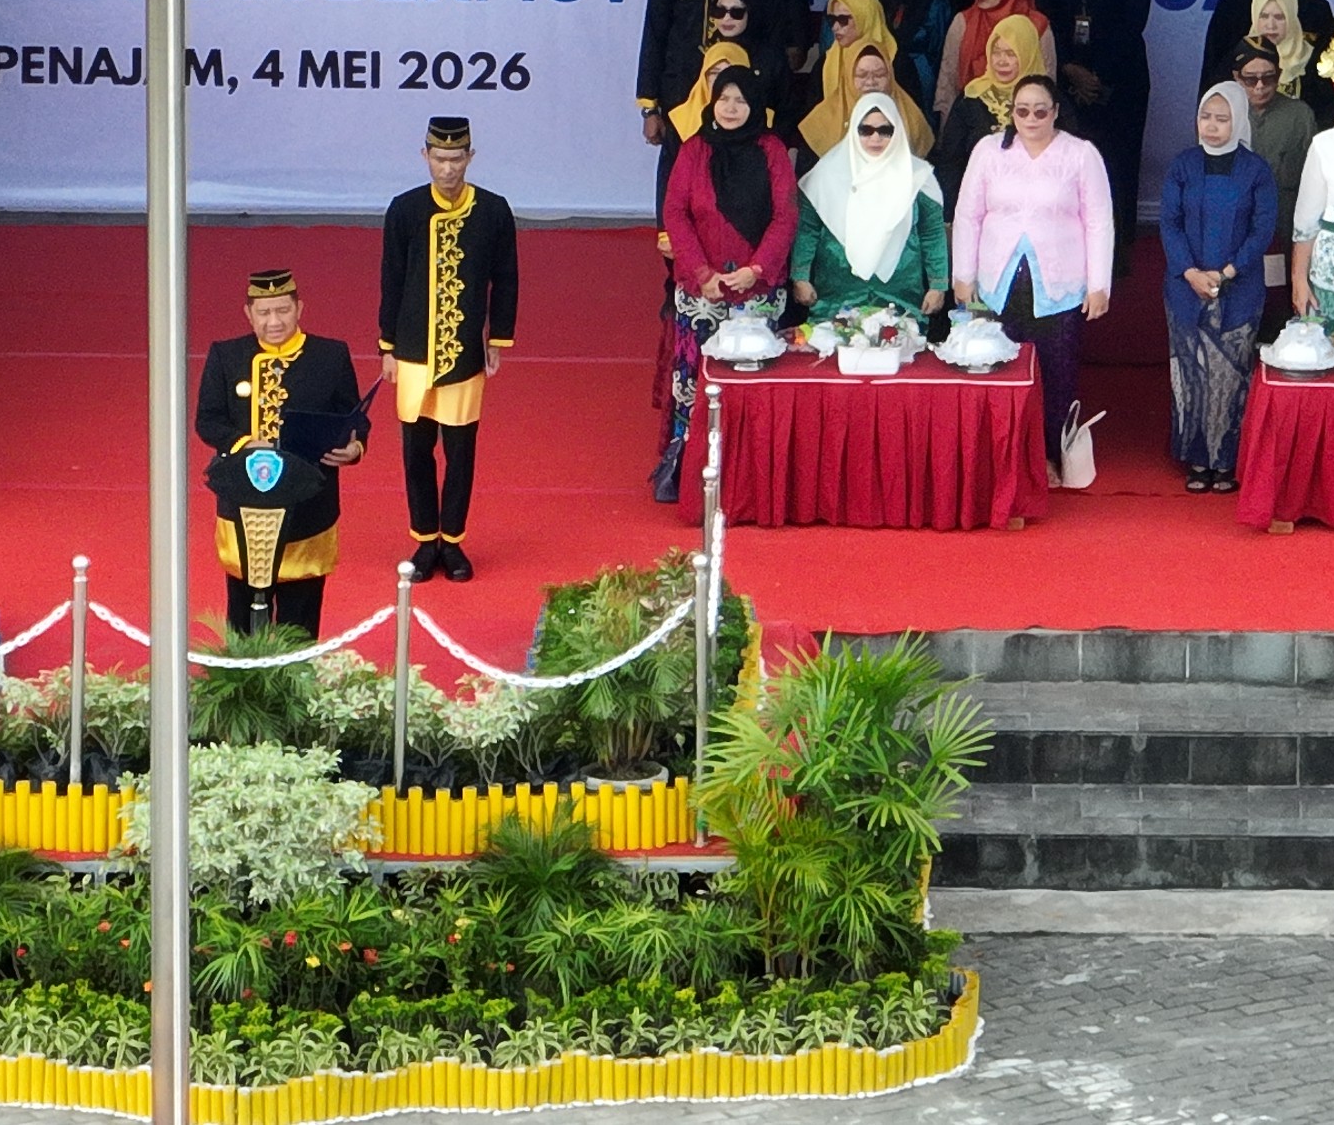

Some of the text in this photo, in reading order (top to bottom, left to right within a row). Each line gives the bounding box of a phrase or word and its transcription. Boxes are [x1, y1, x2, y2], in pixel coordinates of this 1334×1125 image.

[251, 47, 285, 88] 4
[297, 49, 382, 90] MEI
[397, 49, 533, 92] 2026
